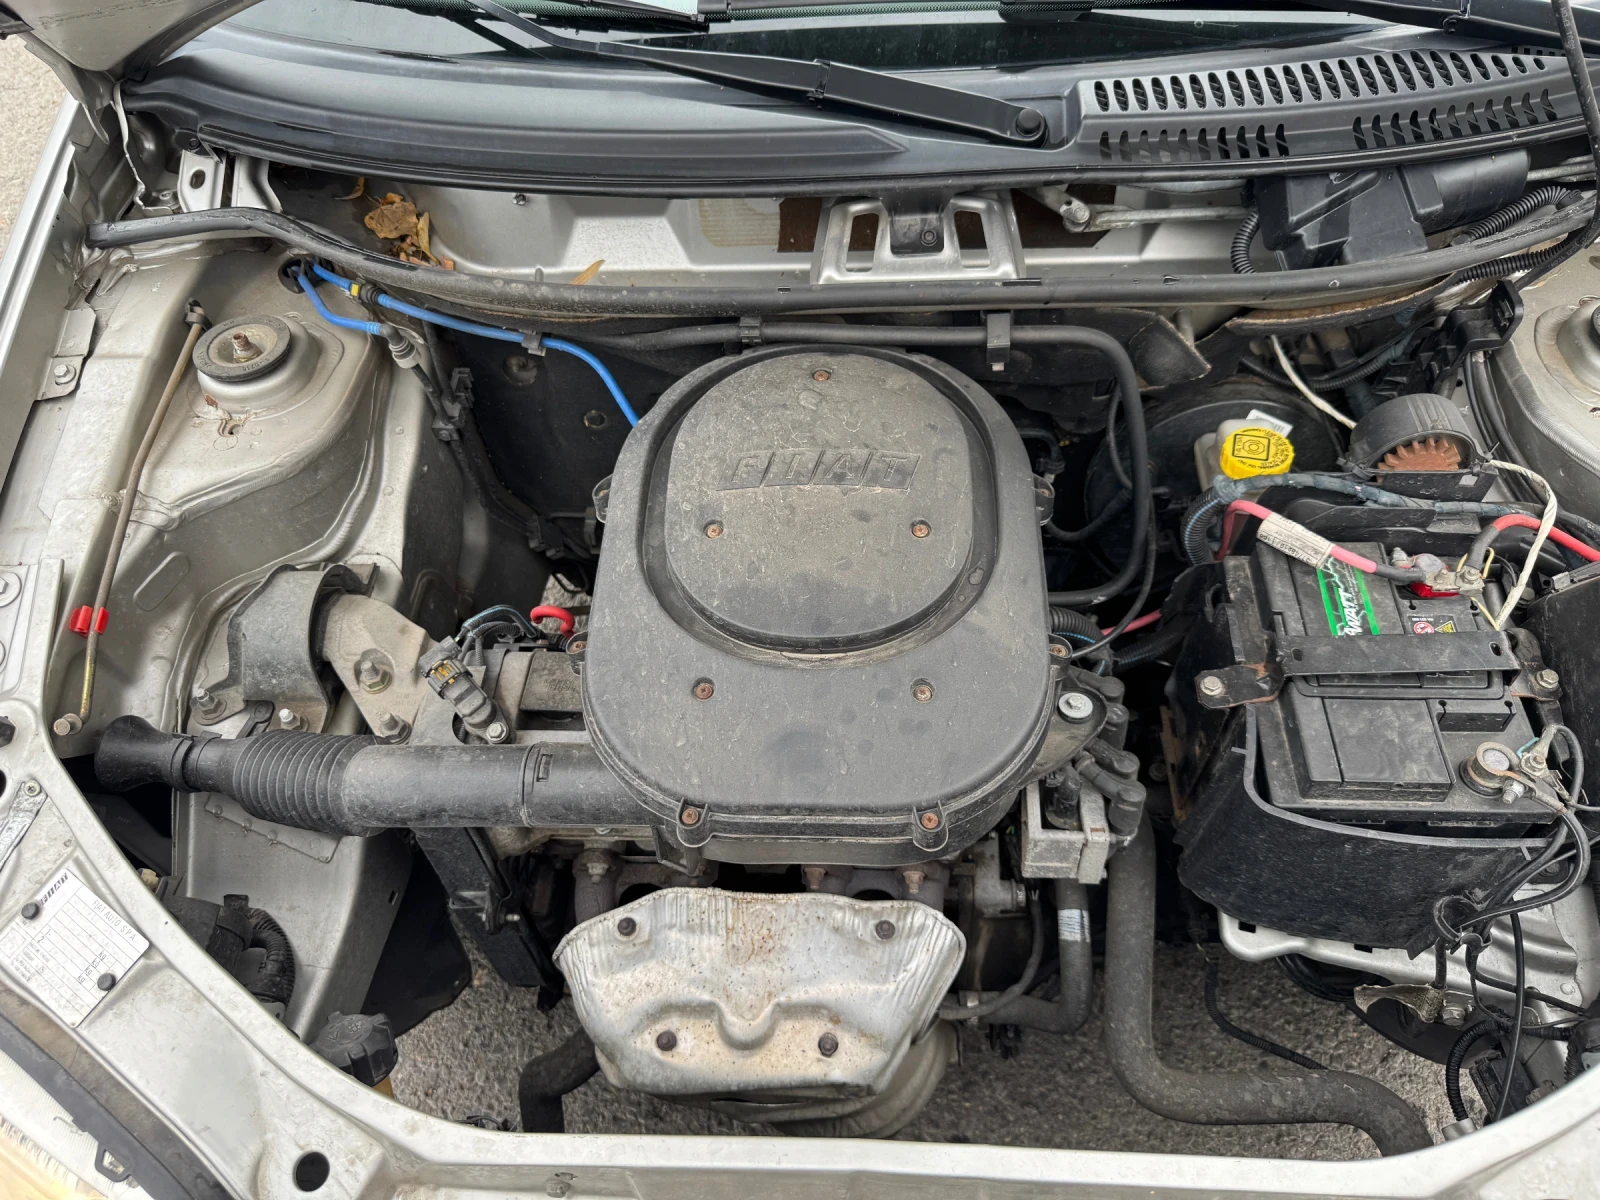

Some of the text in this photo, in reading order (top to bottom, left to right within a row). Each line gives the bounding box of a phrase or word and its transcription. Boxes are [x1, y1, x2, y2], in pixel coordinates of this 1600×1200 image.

[727, 452, 911, 485] FIAT
[40, 872, 68, 906] FIAT
[91, 899, 107, 913] FIAT
[103, 910, 122, 927] AUTO
